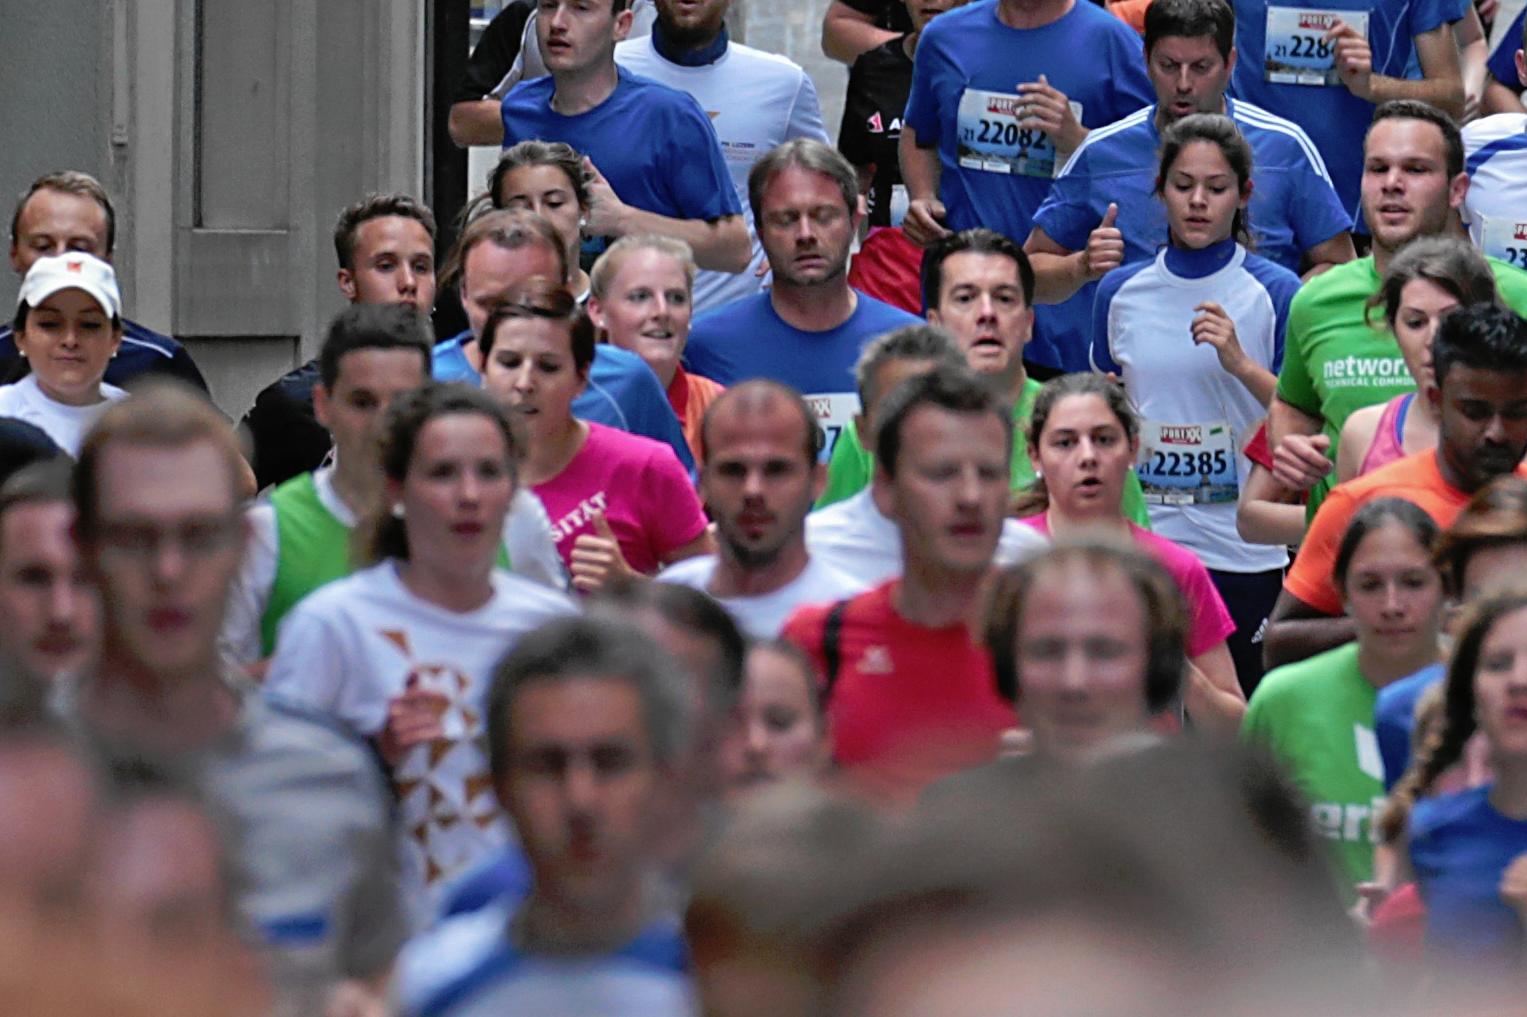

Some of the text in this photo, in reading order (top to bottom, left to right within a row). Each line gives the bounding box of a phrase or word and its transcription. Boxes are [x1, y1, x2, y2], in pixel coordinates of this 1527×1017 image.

[1274, 35, 1335, 58] 21 228
[963, 119, 1047, 150] 21 22082
[1323, 355, 1411, 378] networ
[1153, 449, 1227, 476] 22385
